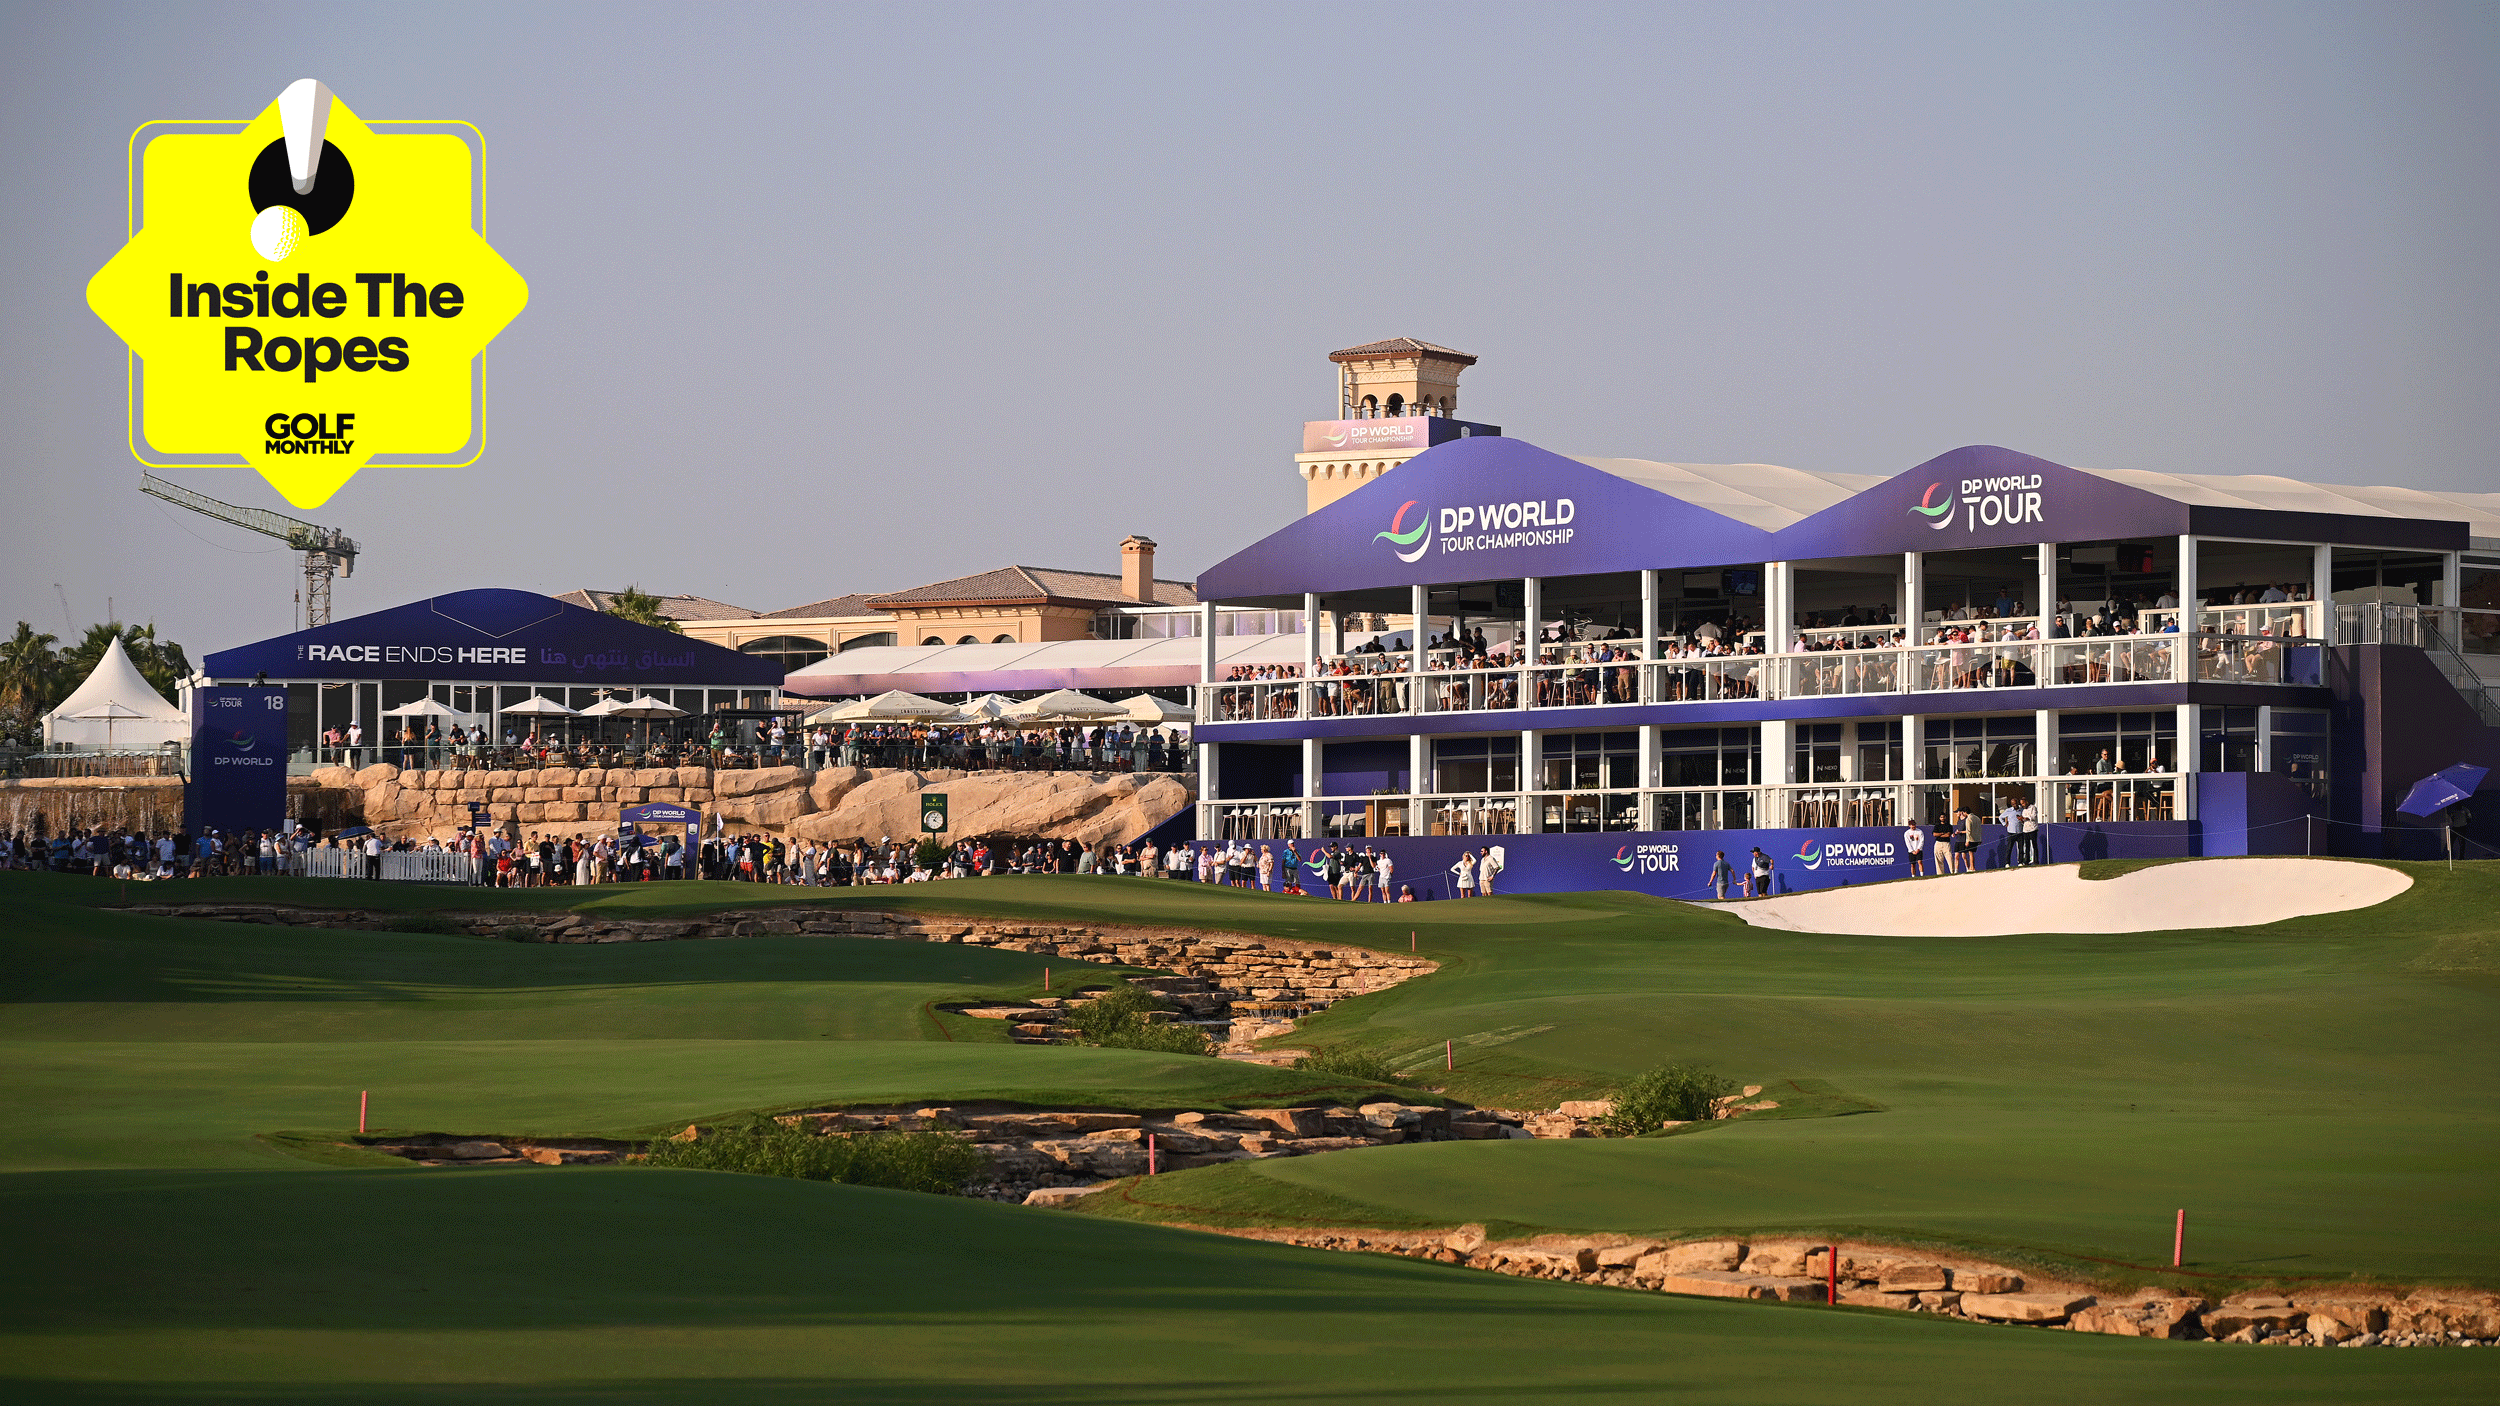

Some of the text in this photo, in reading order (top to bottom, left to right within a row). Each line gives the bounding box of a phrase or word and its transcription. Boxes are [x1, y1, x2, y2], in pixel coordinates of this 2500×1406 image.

[1351, 425, 1414, 437] DP WORLD
[1369, 435, 1414, 443] CHAMPIONSHIP
[1961, 474, 2042, 494] DP WORLD
[1440, 498, 1575, 534] DP WORLD
[1961, 492, 2044, 533] TOUR
[1440, 528, 1574, 555] TOUR CHAMPIONSHIP
[308, 644, 380, 662] RACE
[385, 646, 453, 663] ENDS
[457, 647, 526, 664] HERE
[540, 648, 567, 664] هنا
[264, 695, 284, 710] 18
[214, 757, 273, 766] DP WORLD
[1637, 844, 1679, 854] DP WORLD
[1825, 843, 1895, 857] DP WORLD
[1637, 854, 1680, 875] TOUR
[1826, 857, 1895, 867] TOUR CHAMPIONSHIP
